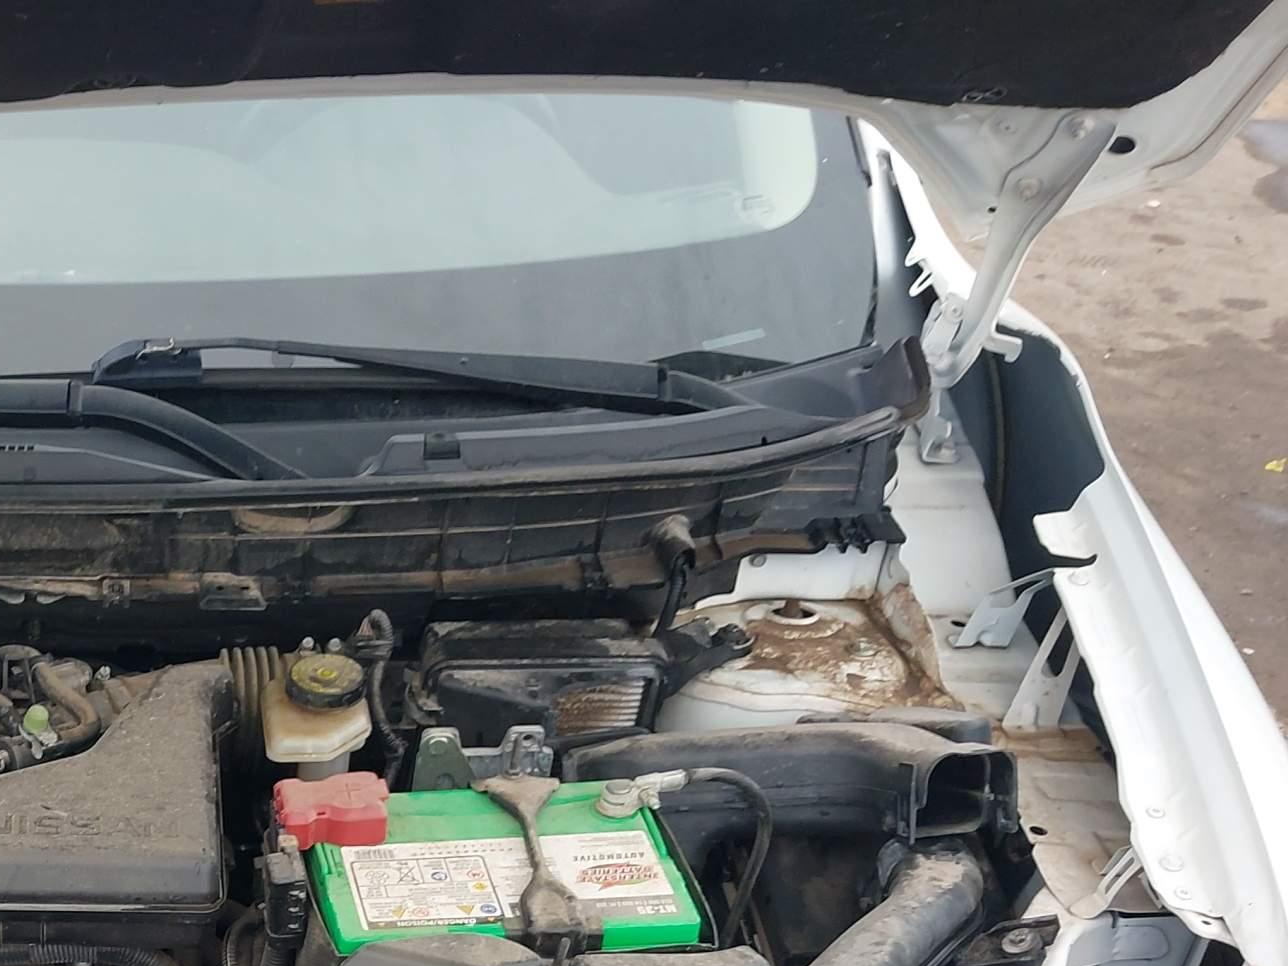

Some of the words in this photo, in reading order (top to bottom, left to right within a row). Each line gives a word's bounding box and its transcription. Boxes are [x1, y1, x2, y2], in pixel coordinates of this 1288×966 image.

[572, 852, 645, 861] AUTOMOTIVE
[581, 865, 654, 875] BATTERIES
[577, 872, 658, 883] INTERSTATE
